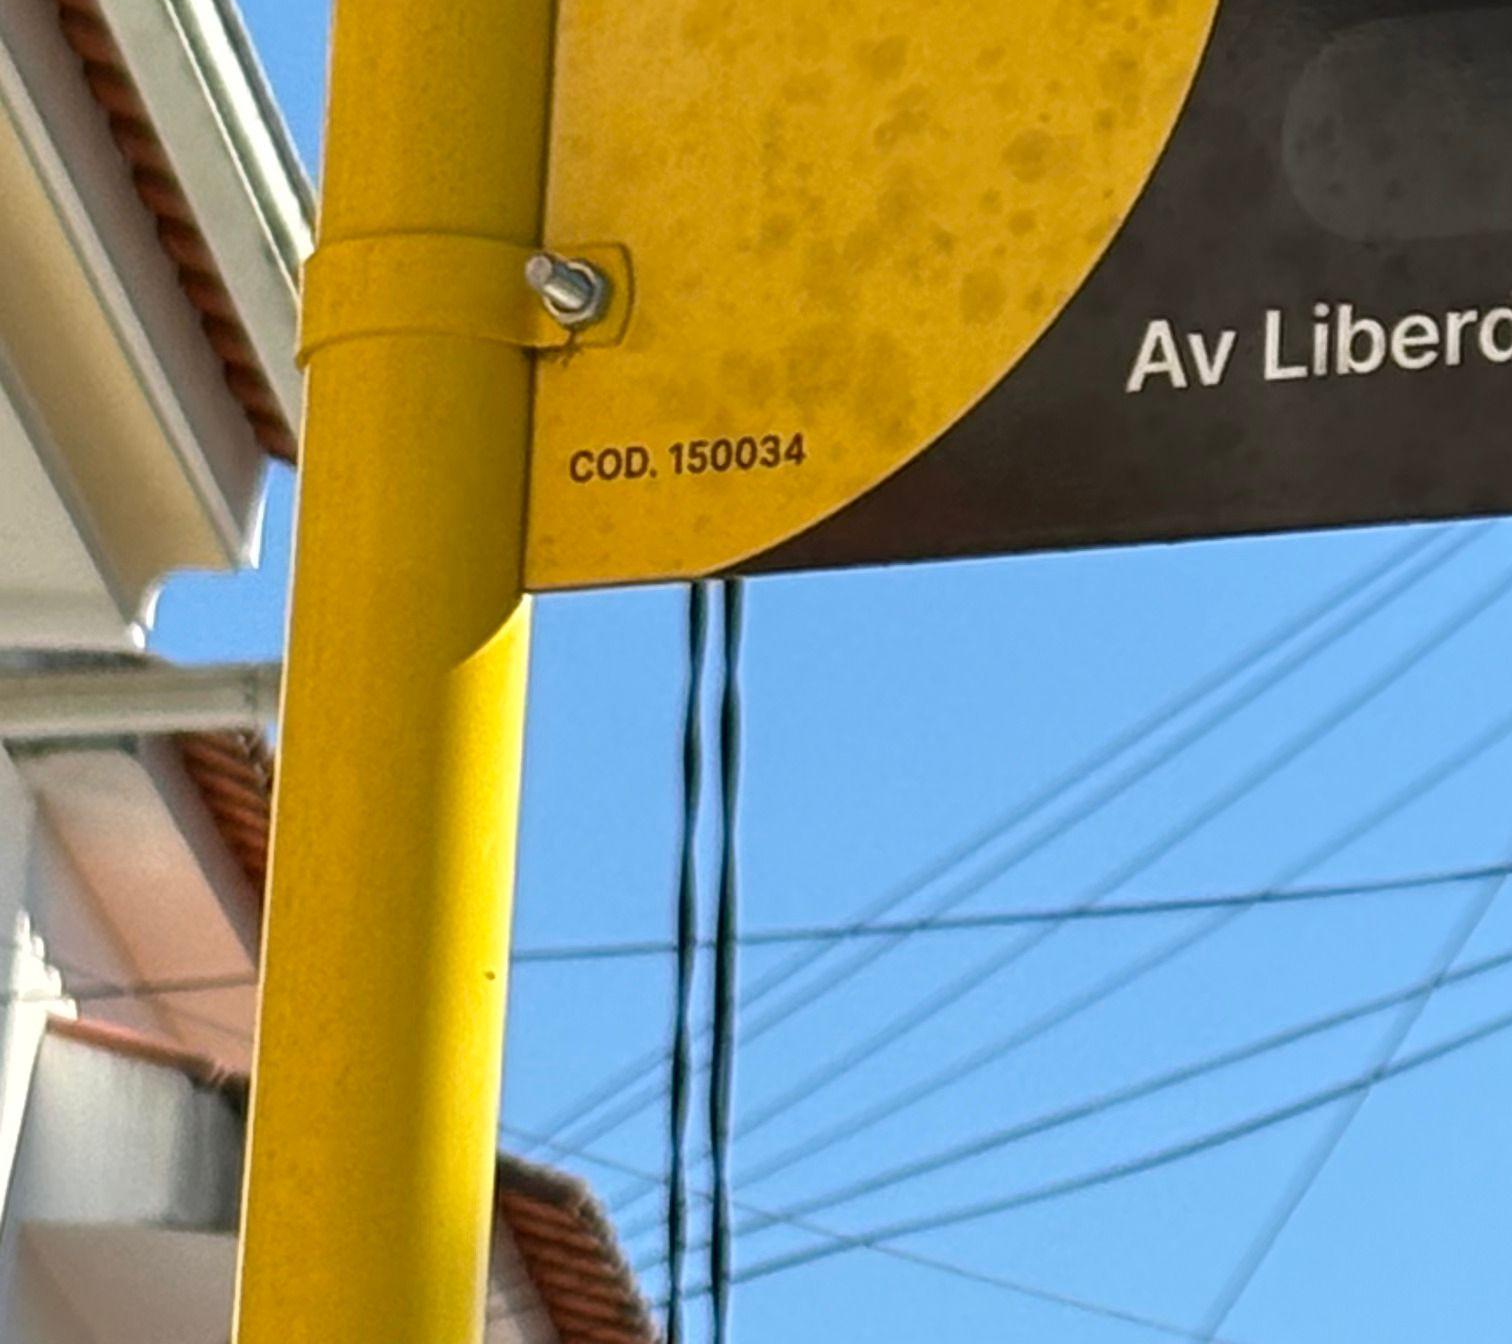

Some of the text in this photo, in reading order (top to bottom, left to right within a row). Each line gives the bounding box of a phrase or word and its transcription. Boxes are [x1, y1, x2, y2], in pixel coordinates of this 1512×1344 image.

[1125, 318, 1237, 393] Av
[569, 432, 807, 484] COD. 150034
